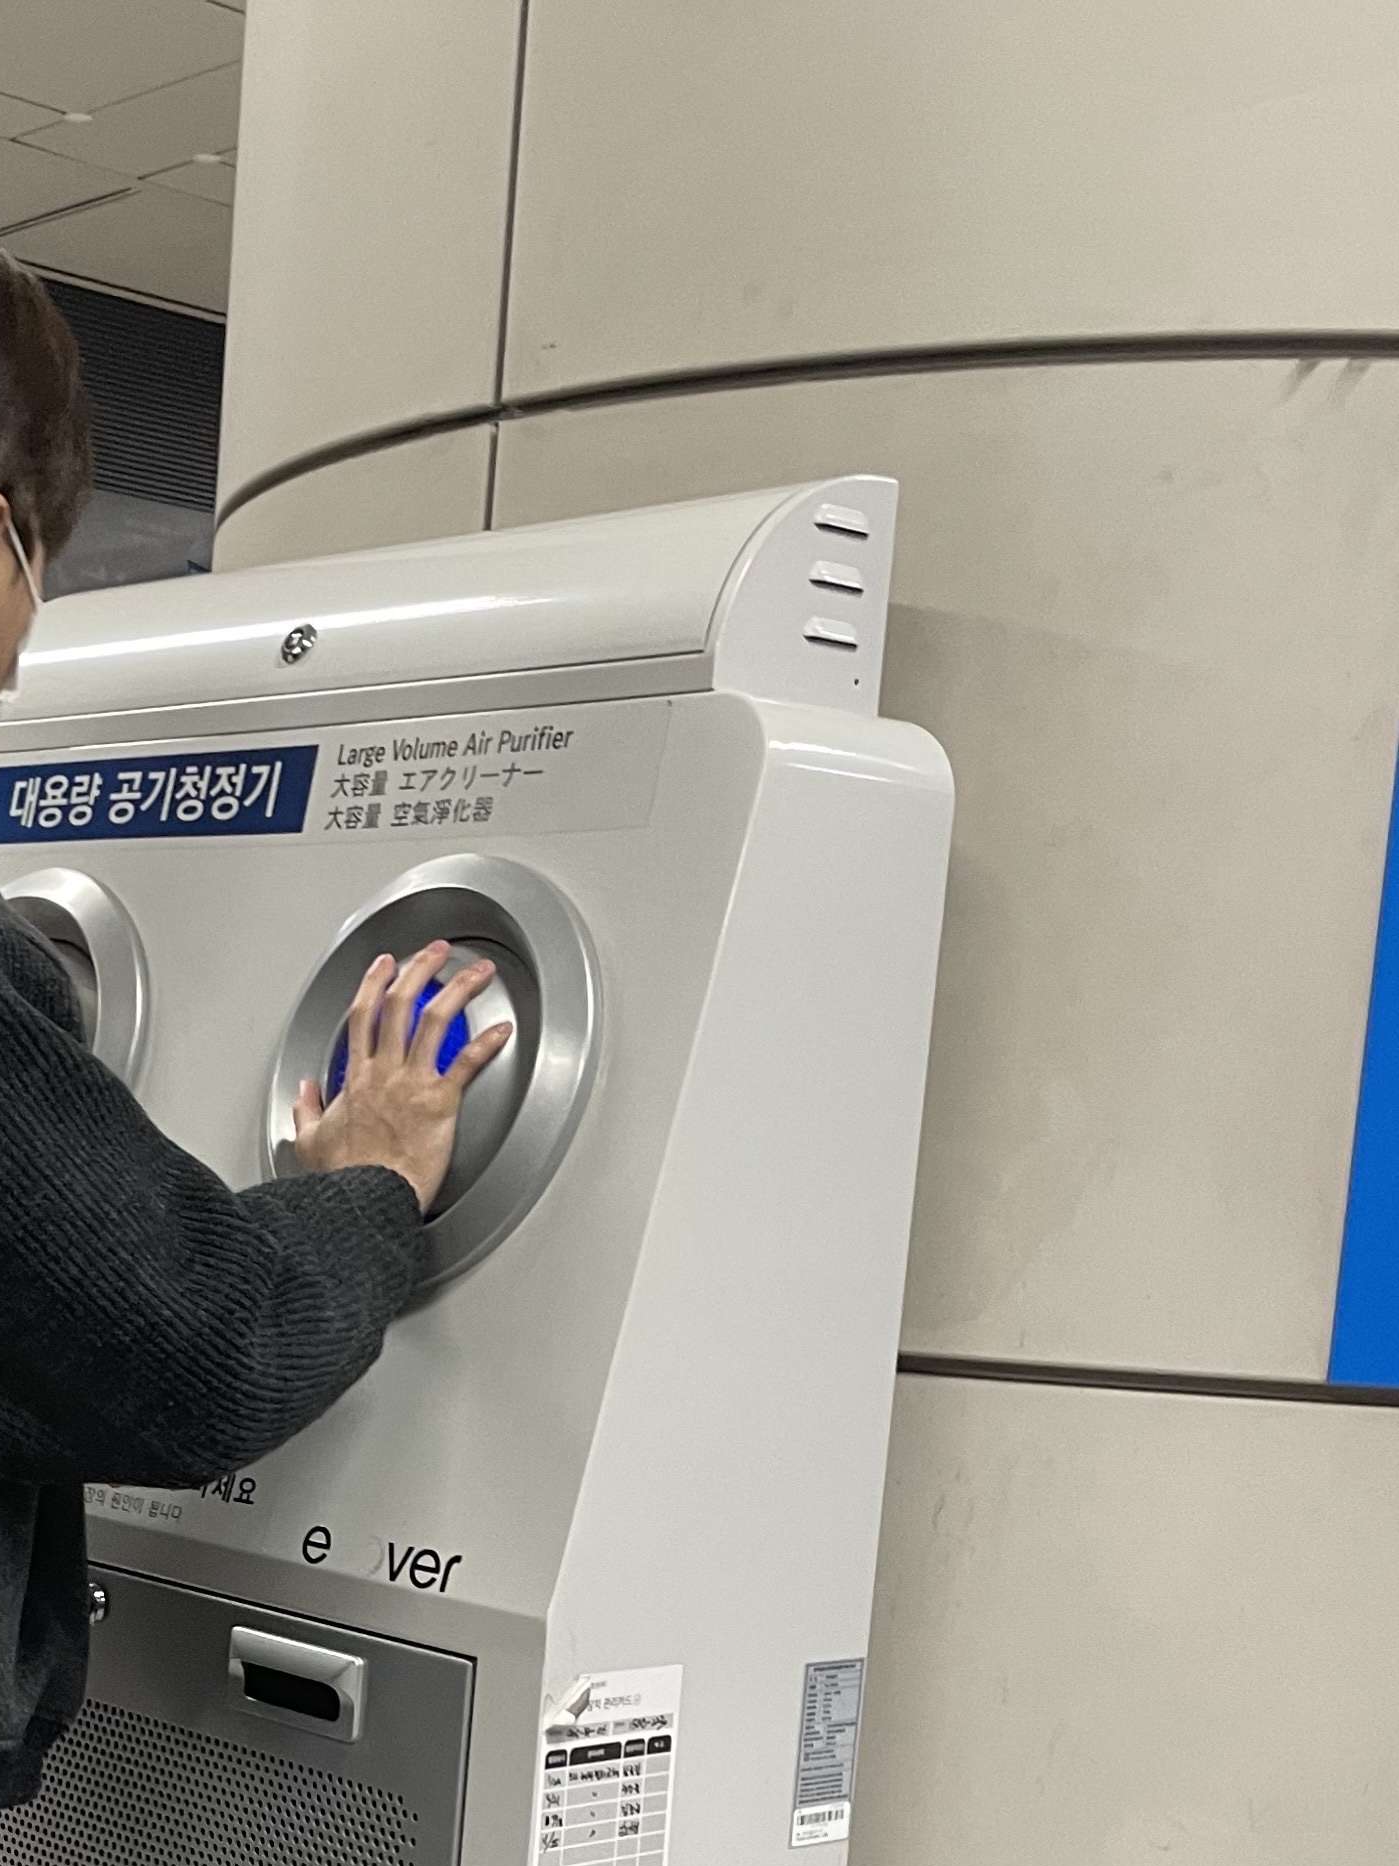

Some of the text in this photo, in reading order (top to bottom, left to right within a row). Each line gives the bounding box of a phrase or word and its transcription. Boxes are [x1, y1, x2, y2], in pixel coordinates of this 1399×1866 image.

[337, 725, 575, 768] Large Volume Air Purifier
[9, 760, 283, 828] 대용량 공기청정기
[330, 761, 544, 798] 大容量 エアクリーナー
[324, 802, 382, 831] 大容量
[201, 1473, 257, 1505] 세요
[148, 1500, 184, 1523] 됩니다
